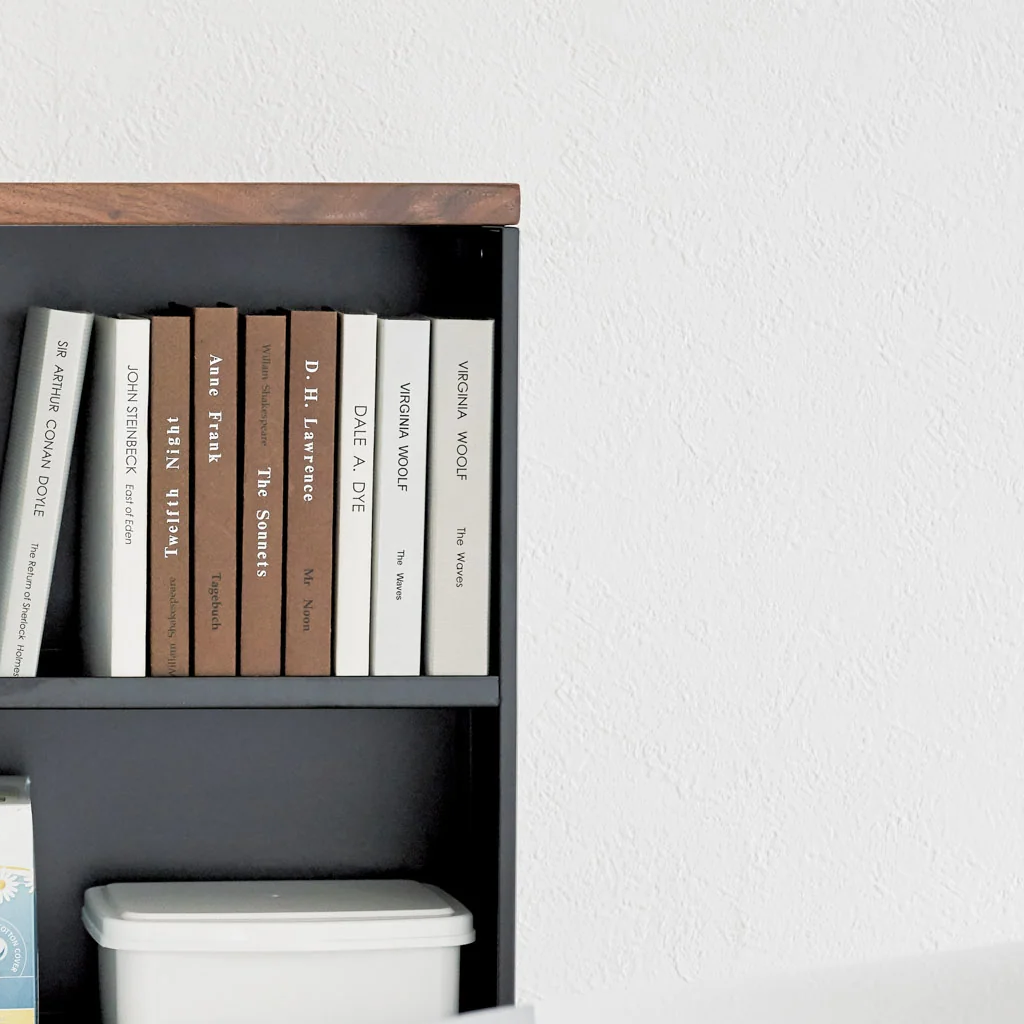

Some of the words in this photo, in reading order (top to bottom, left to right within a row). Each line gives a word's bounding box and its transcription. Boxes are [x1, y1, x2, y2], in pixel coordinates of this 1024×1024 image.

[56, 340, 69, 358] SIR
[48, 364, 65, 413] ARTHUR
[127, 364, 138, 402] JOHN
[208, 354, 224, 397] Anne
[305, 360, 319, 380] D.
[304, 387, 319, 408] H.
[456, 360, 469, 420] VIRGINIA
[259, 384, 270, 447] Shakespeare
[353, 405, 367, 446] DALE
[398, 382, 411, 439] VIRGINIA
[40, 419, 57, 469] CONAN
[125, 406, 138, 474] STEINBECK
[166, 416, 181, 470] Night
[208, 411, 223, 463] Frank
[303, 417, 318, 502] Lawrence
[352, 455, 366, 472] A.
[397, 445, 409, 492] WOOLF
[456, 431, 468, 481] WOOLF
[33, 475, 50, 518] DOYLE
[125, 484, 134, 505] East
[257, 467, 272, 497] The
[351, 482, 365, 512] DYE
[125, 506, 134, 519] of
[164, 488, 180, 558] Twelfth
[125, 519, 134, 545] Eden
[256, 510, 270, 577] Sonnets
[456, 527, 467, 546] The
[29, 543, 39, 559] The
[396, 549, 405, 566] The
[456, 551, 466, 588] Waves
[25, 560, 36, 590] Return
[303, 568, 314, 587] Mr
[395, 572, 404, 600] Waves
[23, 591, 32, 602] of
[167, 576, 179, 638] Shakespeare
[208, 572, 222, 631] Tagebuch
[18, 602, 31, 640] Sherlock
[302, 599, 314, 632] Noon
[12, 644, 25, 677] Holmes
[10, 948, 21, 973] COVER
